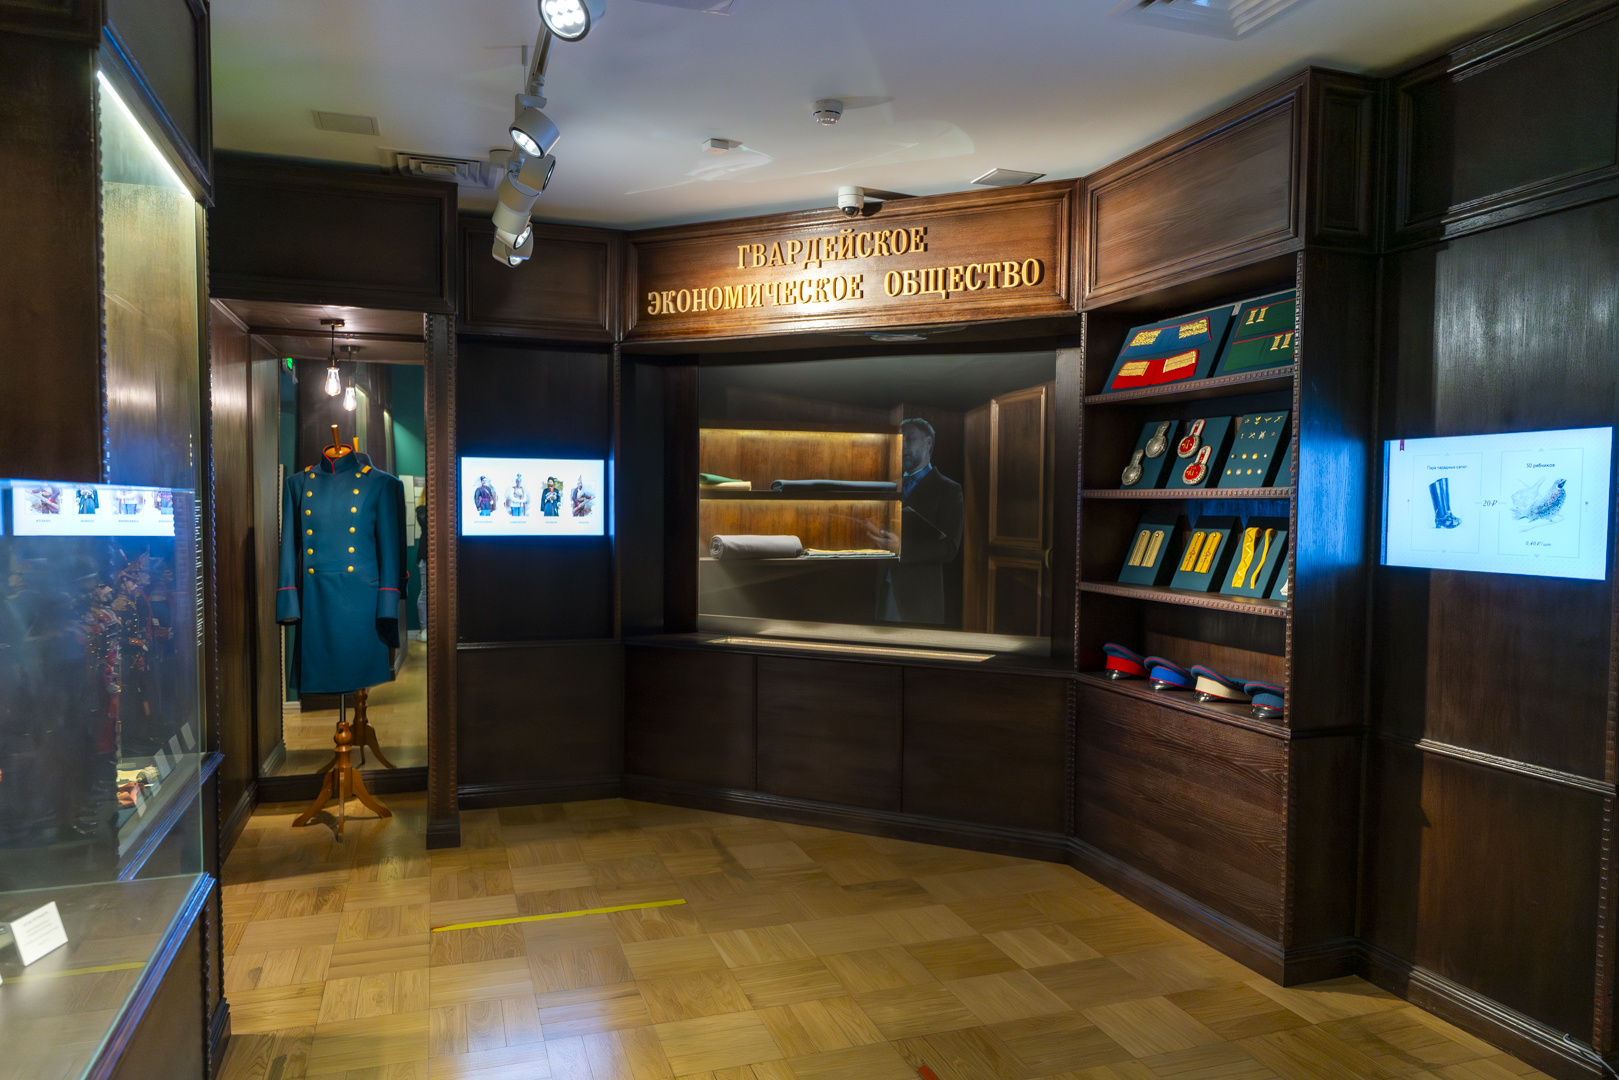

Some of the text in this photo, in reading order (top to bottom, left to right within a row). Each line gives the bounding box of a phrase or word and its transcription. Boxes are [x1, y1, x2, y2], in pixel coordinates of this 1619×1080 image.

[736, 226, 928, 269] ГВАРДЕЙСКОЕ
[647, 258, 1045, 315] ЭКОНОМИЧЕСКОЕ ОБЩЕСТВО
